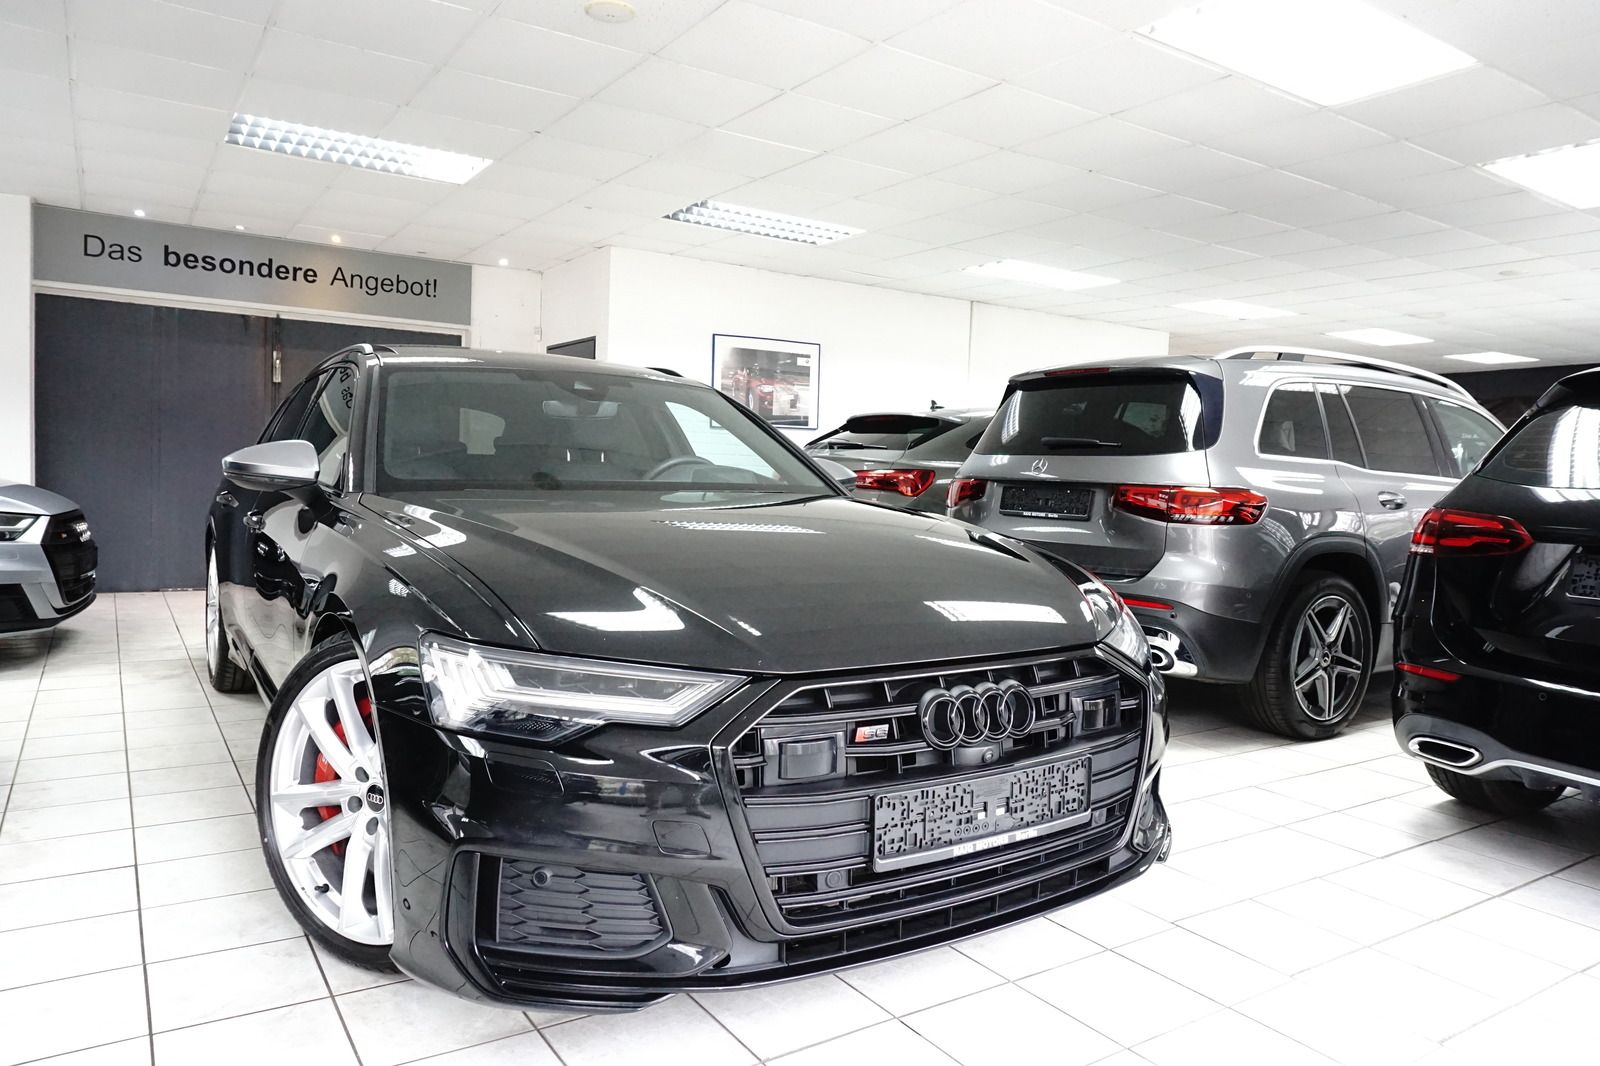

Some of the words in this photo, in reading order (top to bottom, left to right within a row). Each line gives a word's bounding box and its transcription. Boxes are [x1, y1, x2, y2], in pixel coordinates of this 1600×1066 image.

[83, 233, 143, 263] Das
[163, 244, 318, 284] besondere
[330, 266, 438, 298] Angebot!
[861, 725, 889, 741] S6
